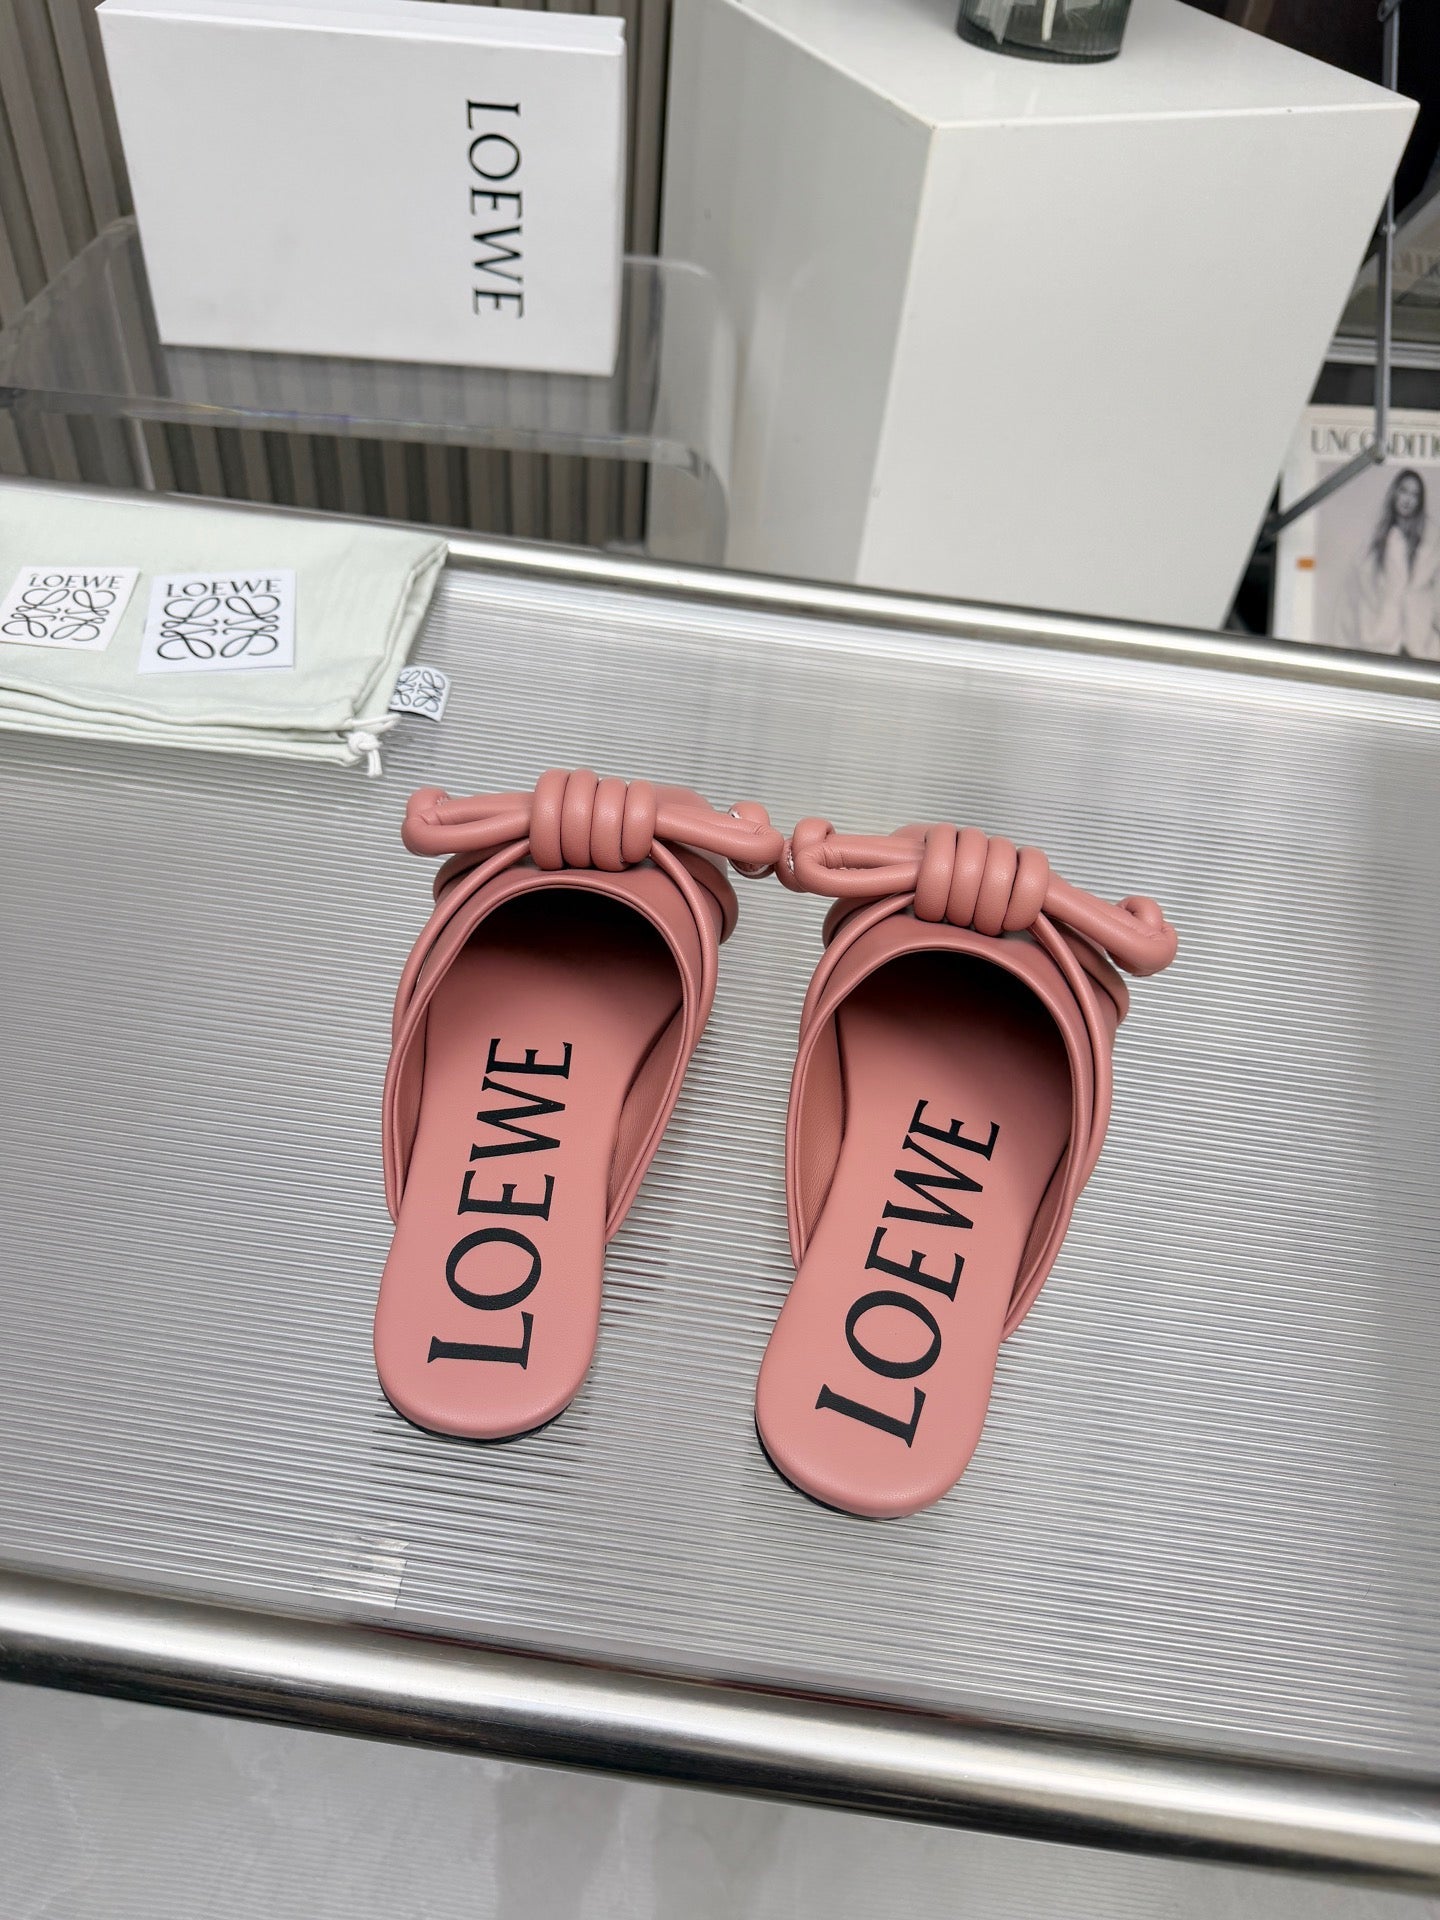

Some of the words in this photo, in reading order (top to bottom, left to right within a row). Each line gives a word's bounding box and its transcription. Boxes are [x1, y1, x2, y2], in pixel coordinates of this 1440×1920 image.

[467, 99, 524, 318] LOEWE
[29, 573, 124, 589] LOEWE
[166, 578, 282, 598] LOEWE
[427, 1038, 573, 1370] LOEWE
[815, 1099, 1000, 1448] LOEWE
